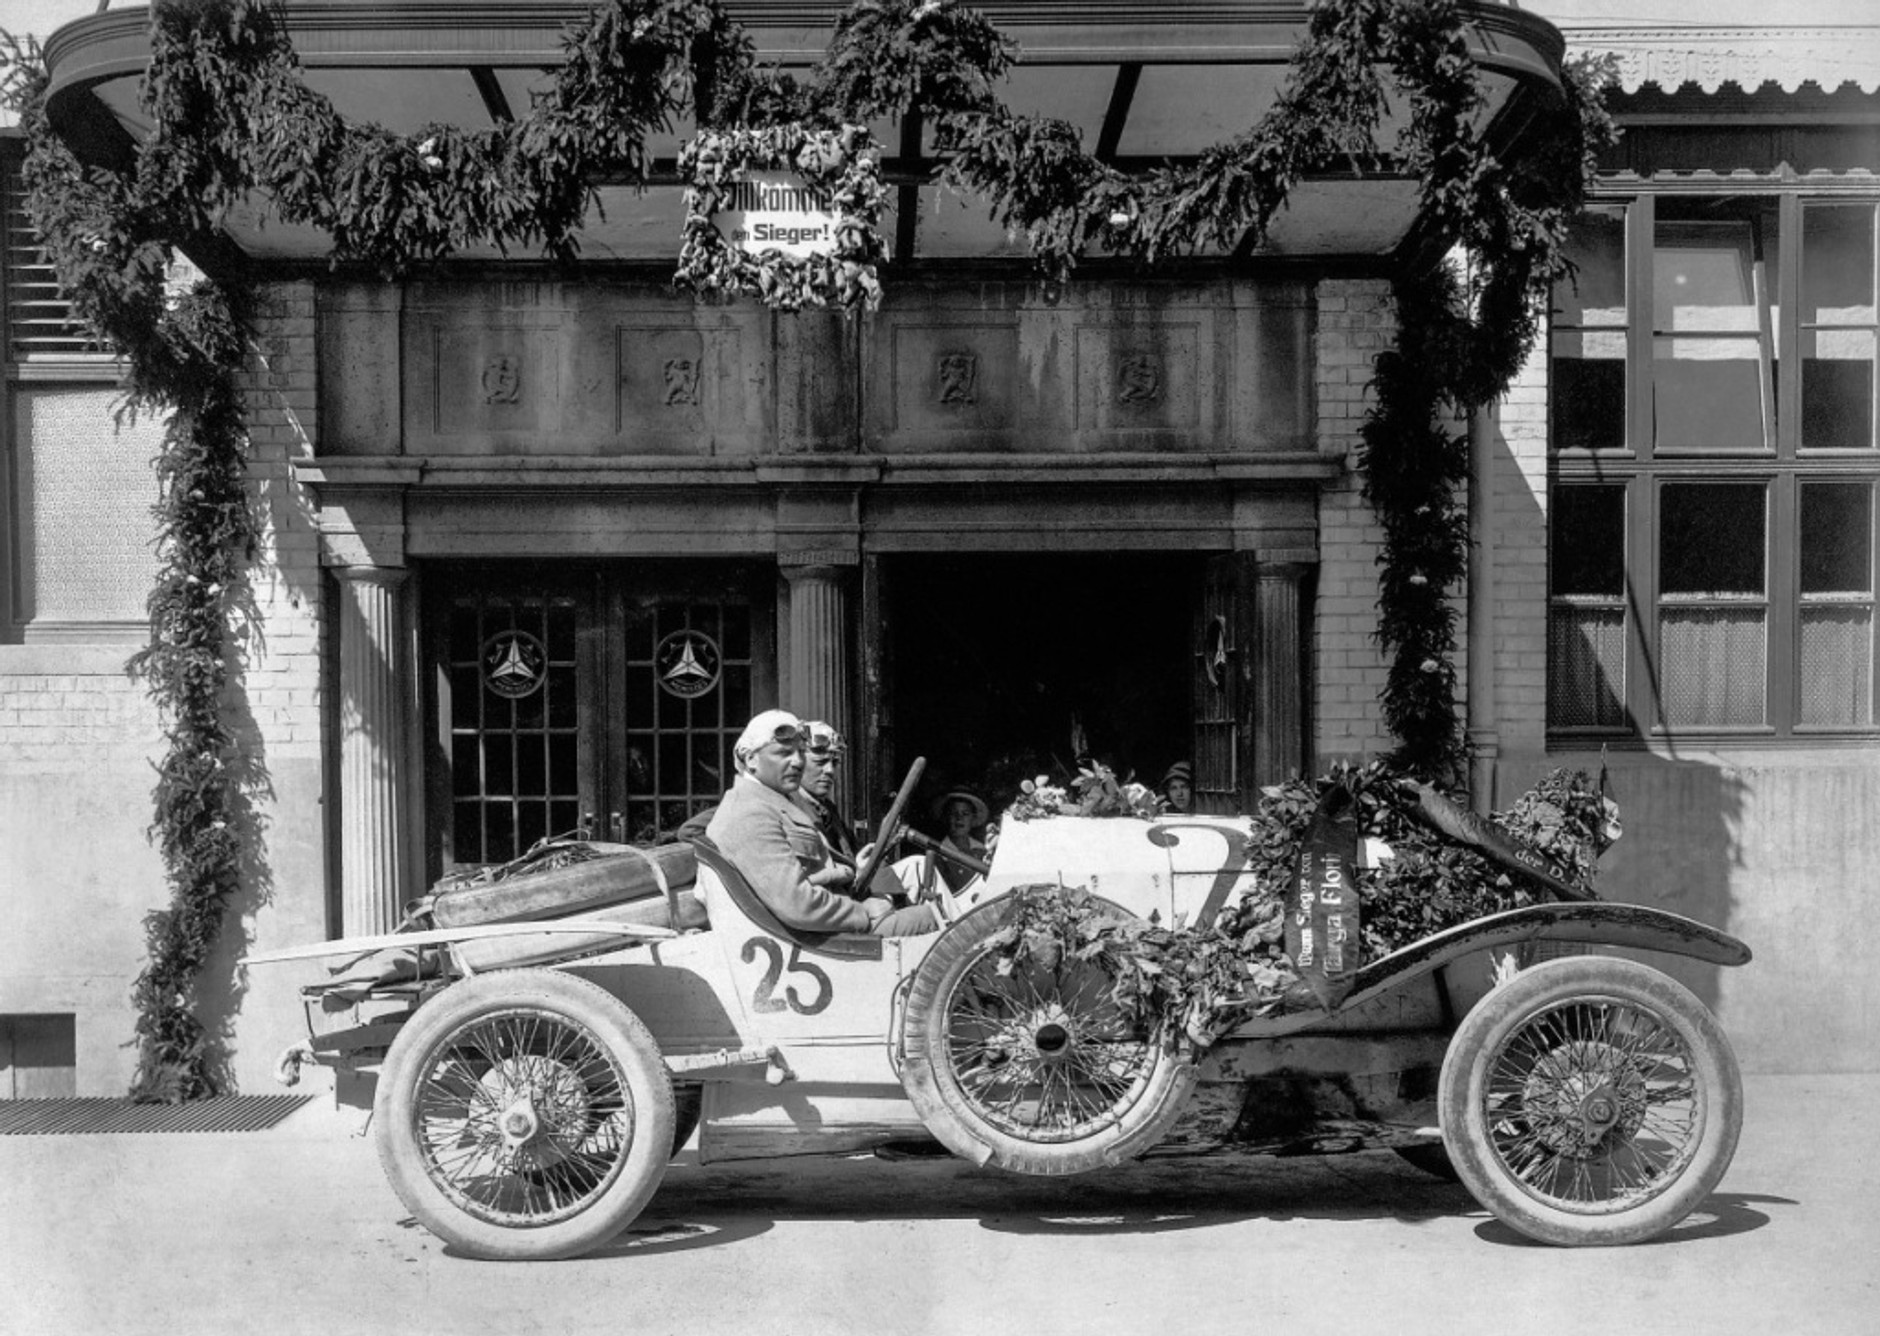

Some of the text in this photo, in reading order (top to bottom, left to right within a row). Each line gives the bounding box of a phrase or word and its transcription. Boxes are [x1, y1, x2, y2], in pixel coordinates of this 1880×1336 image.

[726, 182, 838, 212] illkomme
[753, 223, 829, 245] Sieger!
[1515, 850, 1543, 867] der
[1296, 878, 1315, 926] Sieger
[741, 936, 833, 1015] 25
